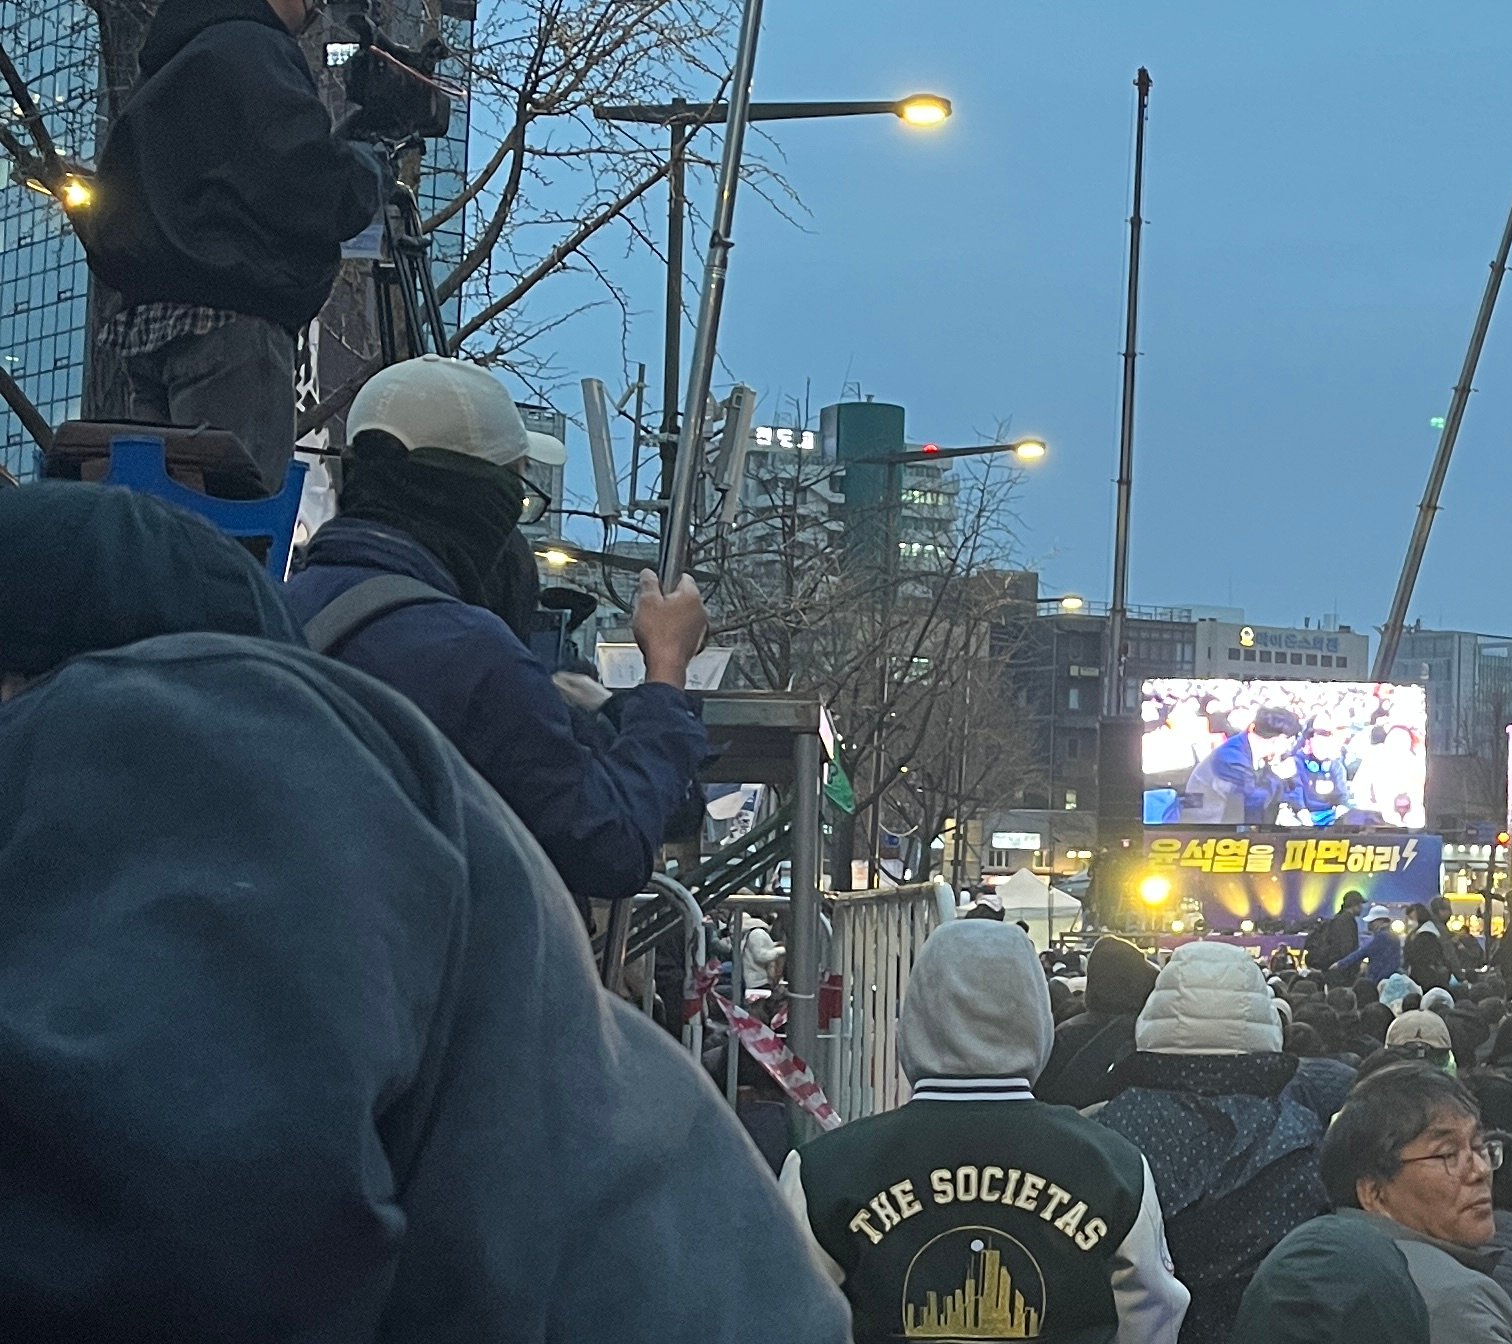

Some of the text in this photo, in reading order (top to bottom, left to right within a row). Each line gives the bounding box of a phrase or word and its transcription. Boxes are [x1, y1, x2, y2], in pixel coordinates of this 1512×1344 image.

[1148, 838, 1401, 873] 윤석열을 파면하라
[849, 1165, 1108, 1252] THE SOCIETAS
